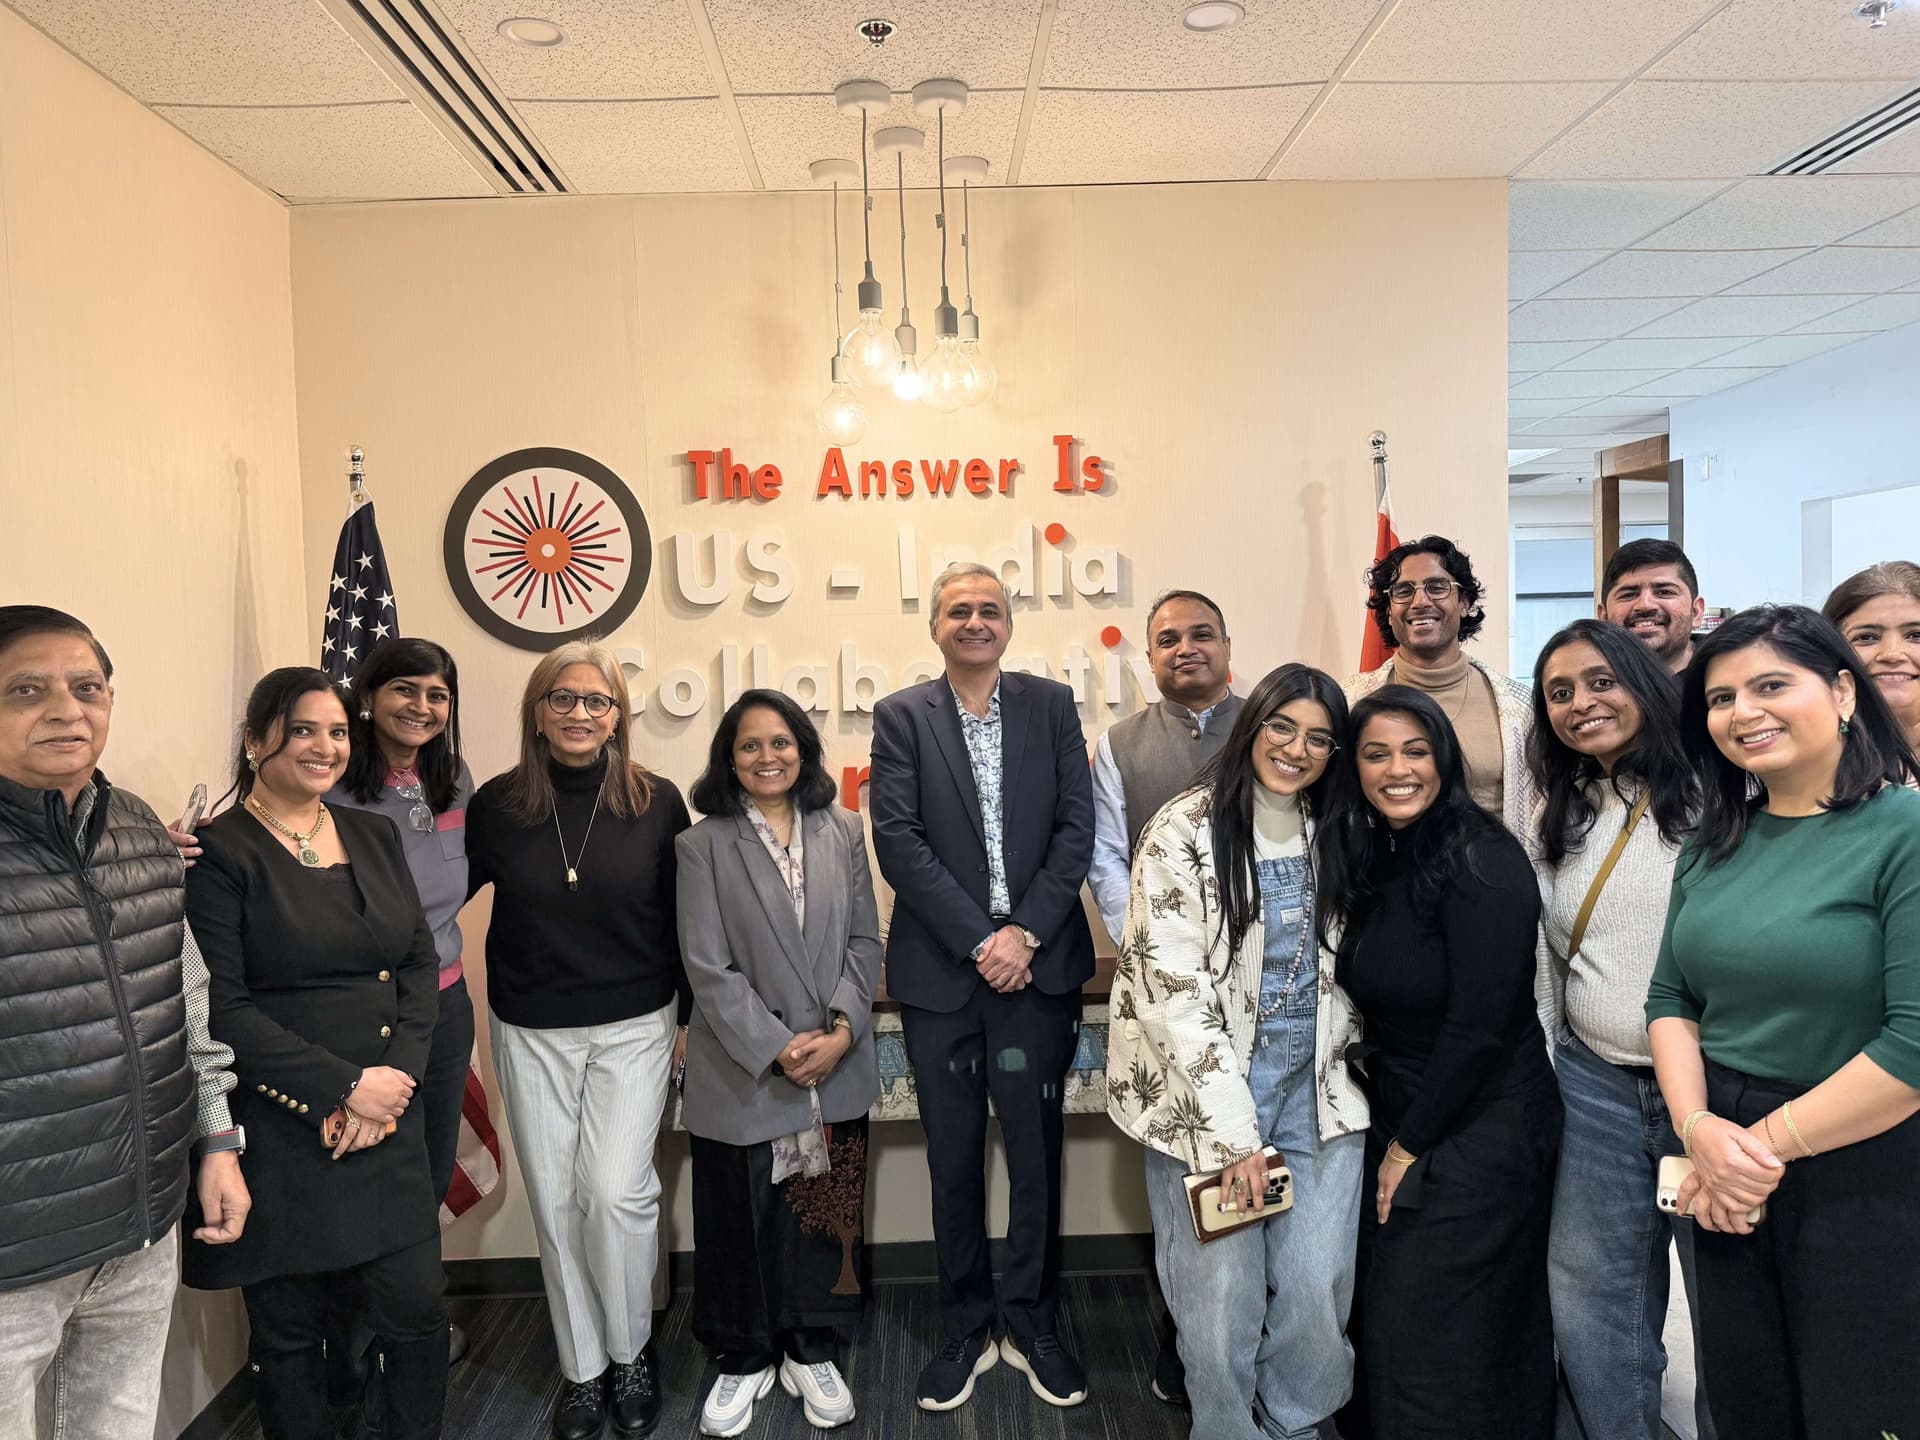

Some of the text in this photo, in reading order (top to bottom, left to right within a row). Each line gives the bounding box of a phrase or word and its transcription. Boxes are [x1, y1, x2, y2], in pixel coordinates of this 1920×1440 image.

[687, 434, 1105, 500] The Answer Is
[675, 527, 795, 605] US
